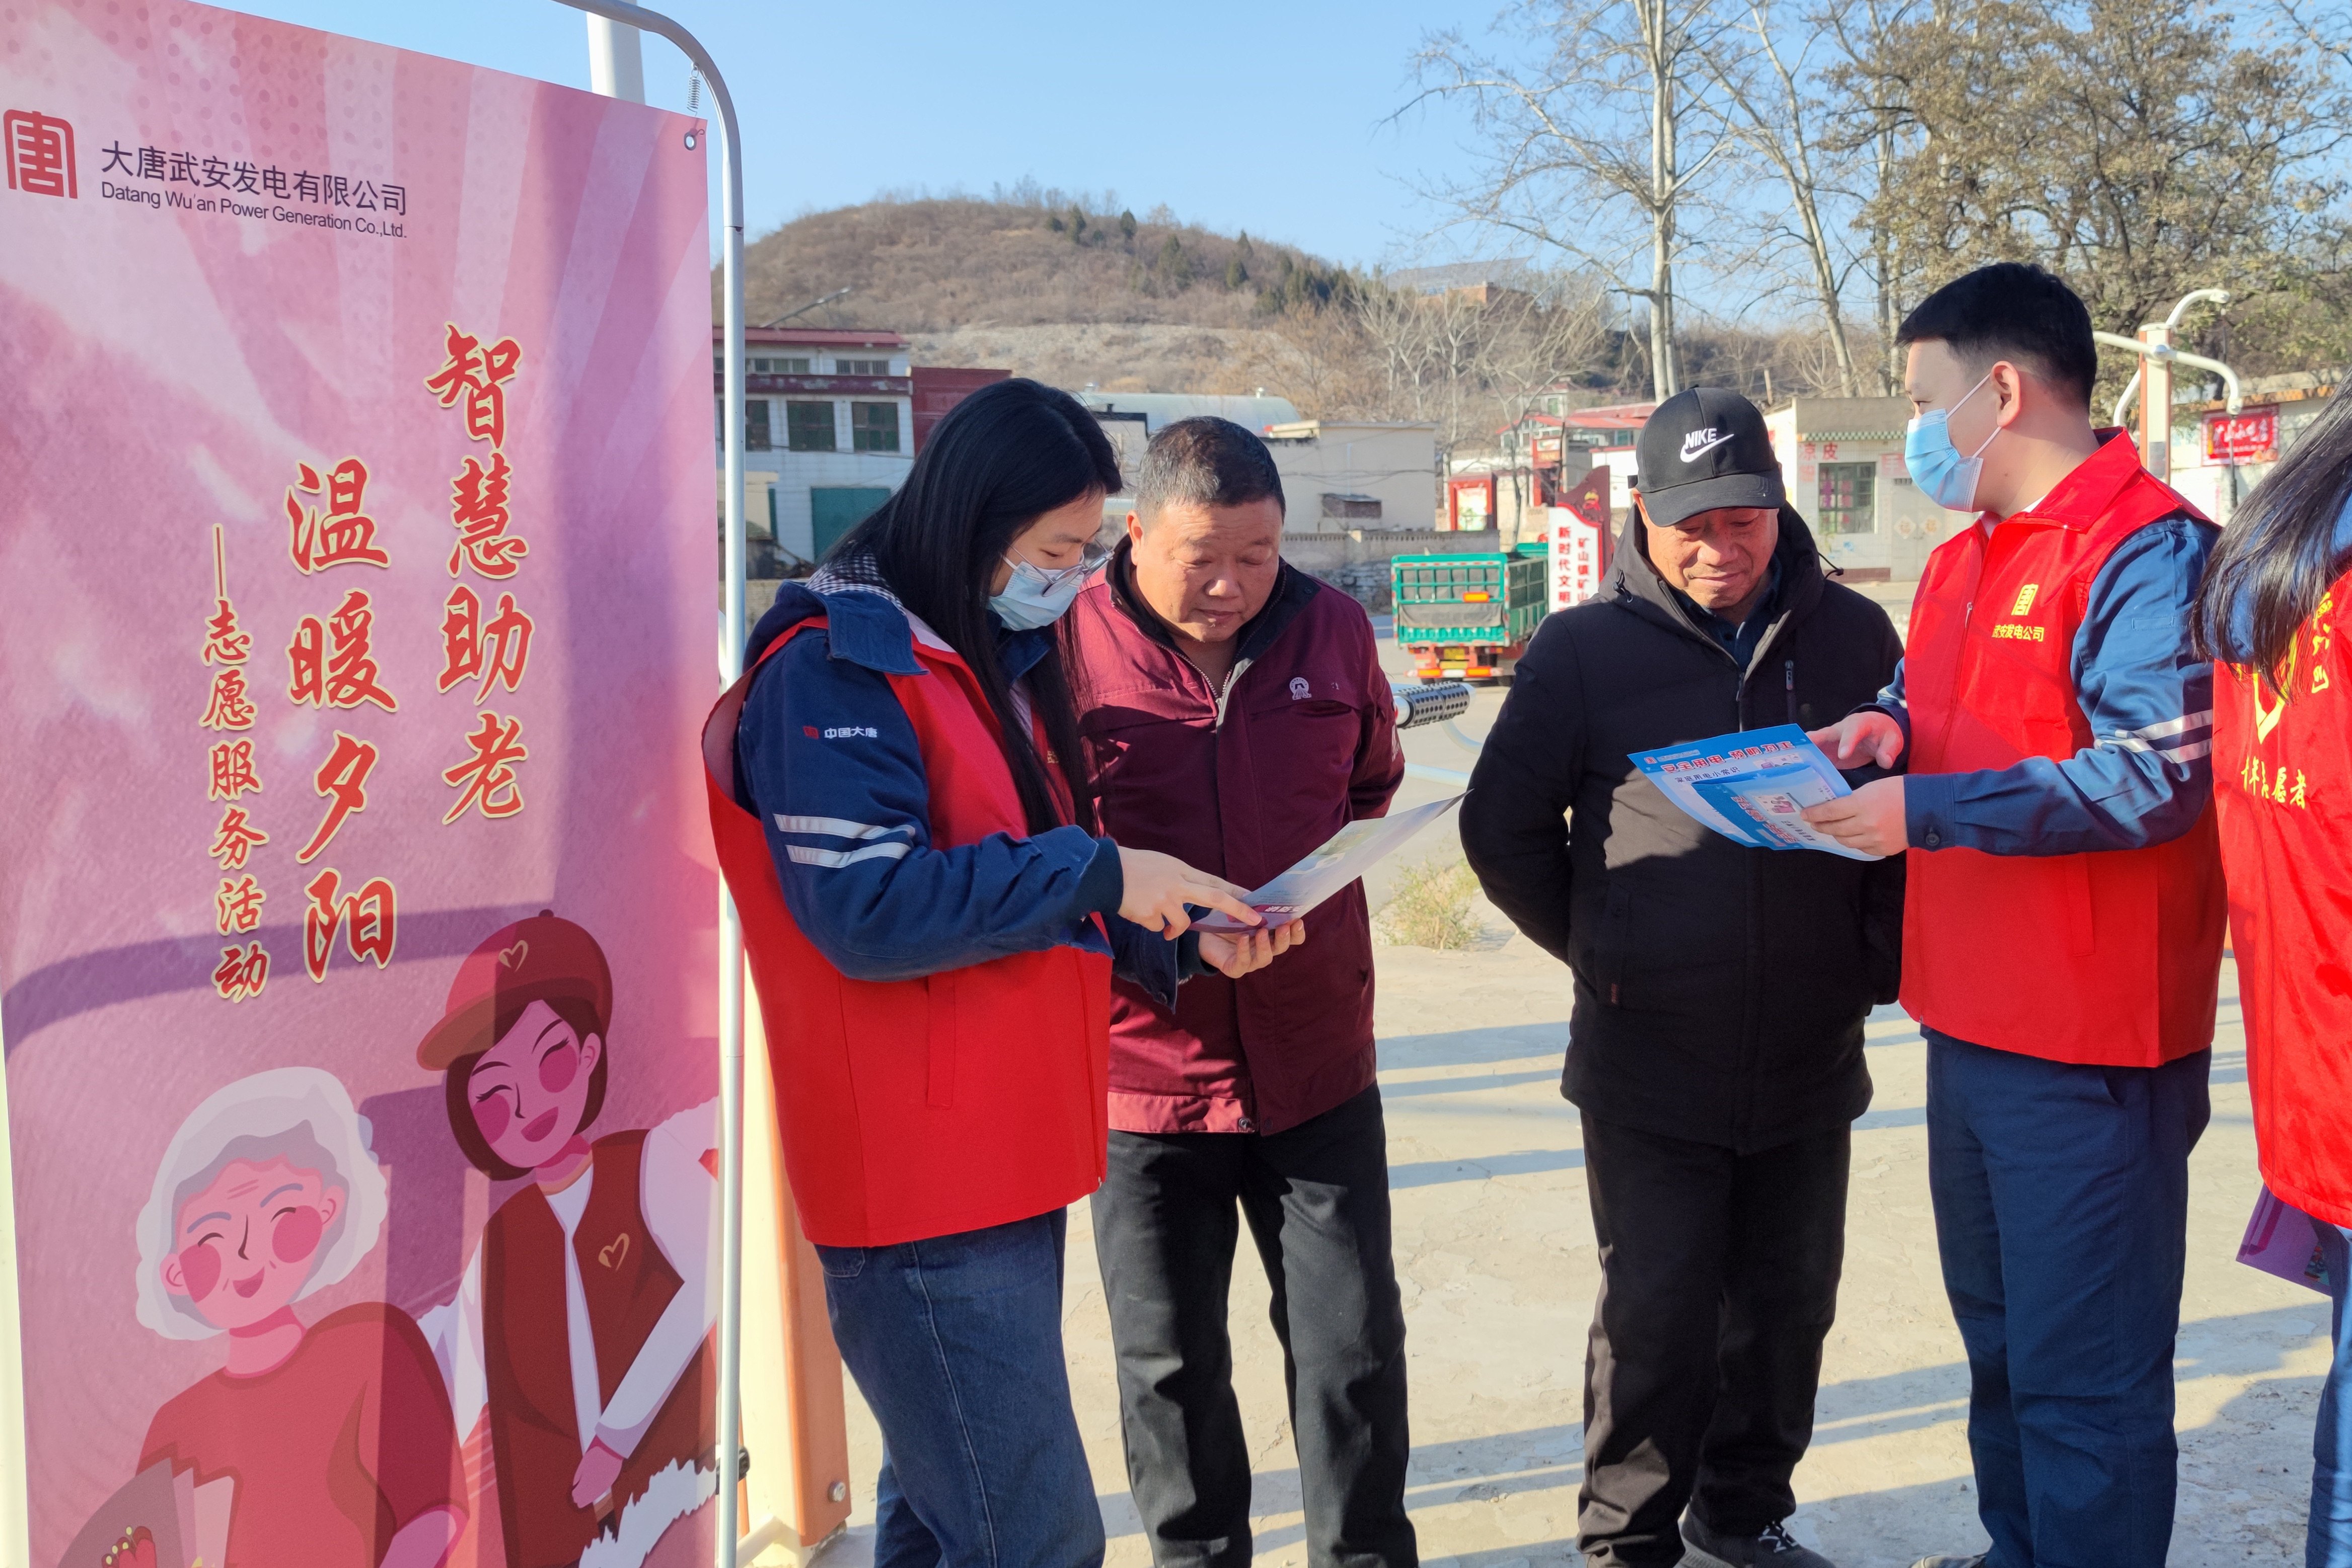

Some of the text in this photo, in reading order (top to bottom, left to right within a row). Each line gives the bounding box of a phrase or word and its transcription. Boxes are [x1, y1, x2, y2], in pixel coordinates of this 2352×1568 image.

[101, 140, 407, 216] 大唐武安发电有限公司
[102, 182, 161, 209] Datang
[221, 199, 269, 219] Power
[273, 205, 351, 232] Generation
[355, 216, 407, 239] Co.,Ltd.
[1684, 428, 1717, 449] NIKE
[425, 323, 535, 825] 智慧助老
[1559, 527, 1571, 612] 新时代文明
[1992, 624, 2045, 642] 武安发电公司
[284, 457, 398, 983] 温暖夕阳
[824, 726, 877, 739] 中国大唐
[1661, 755, 1725, 773] 安全用电
[1728, 741, 1796, 760] 预防为主
[1675, 766, 1741, 783] 家庭用电小常识
